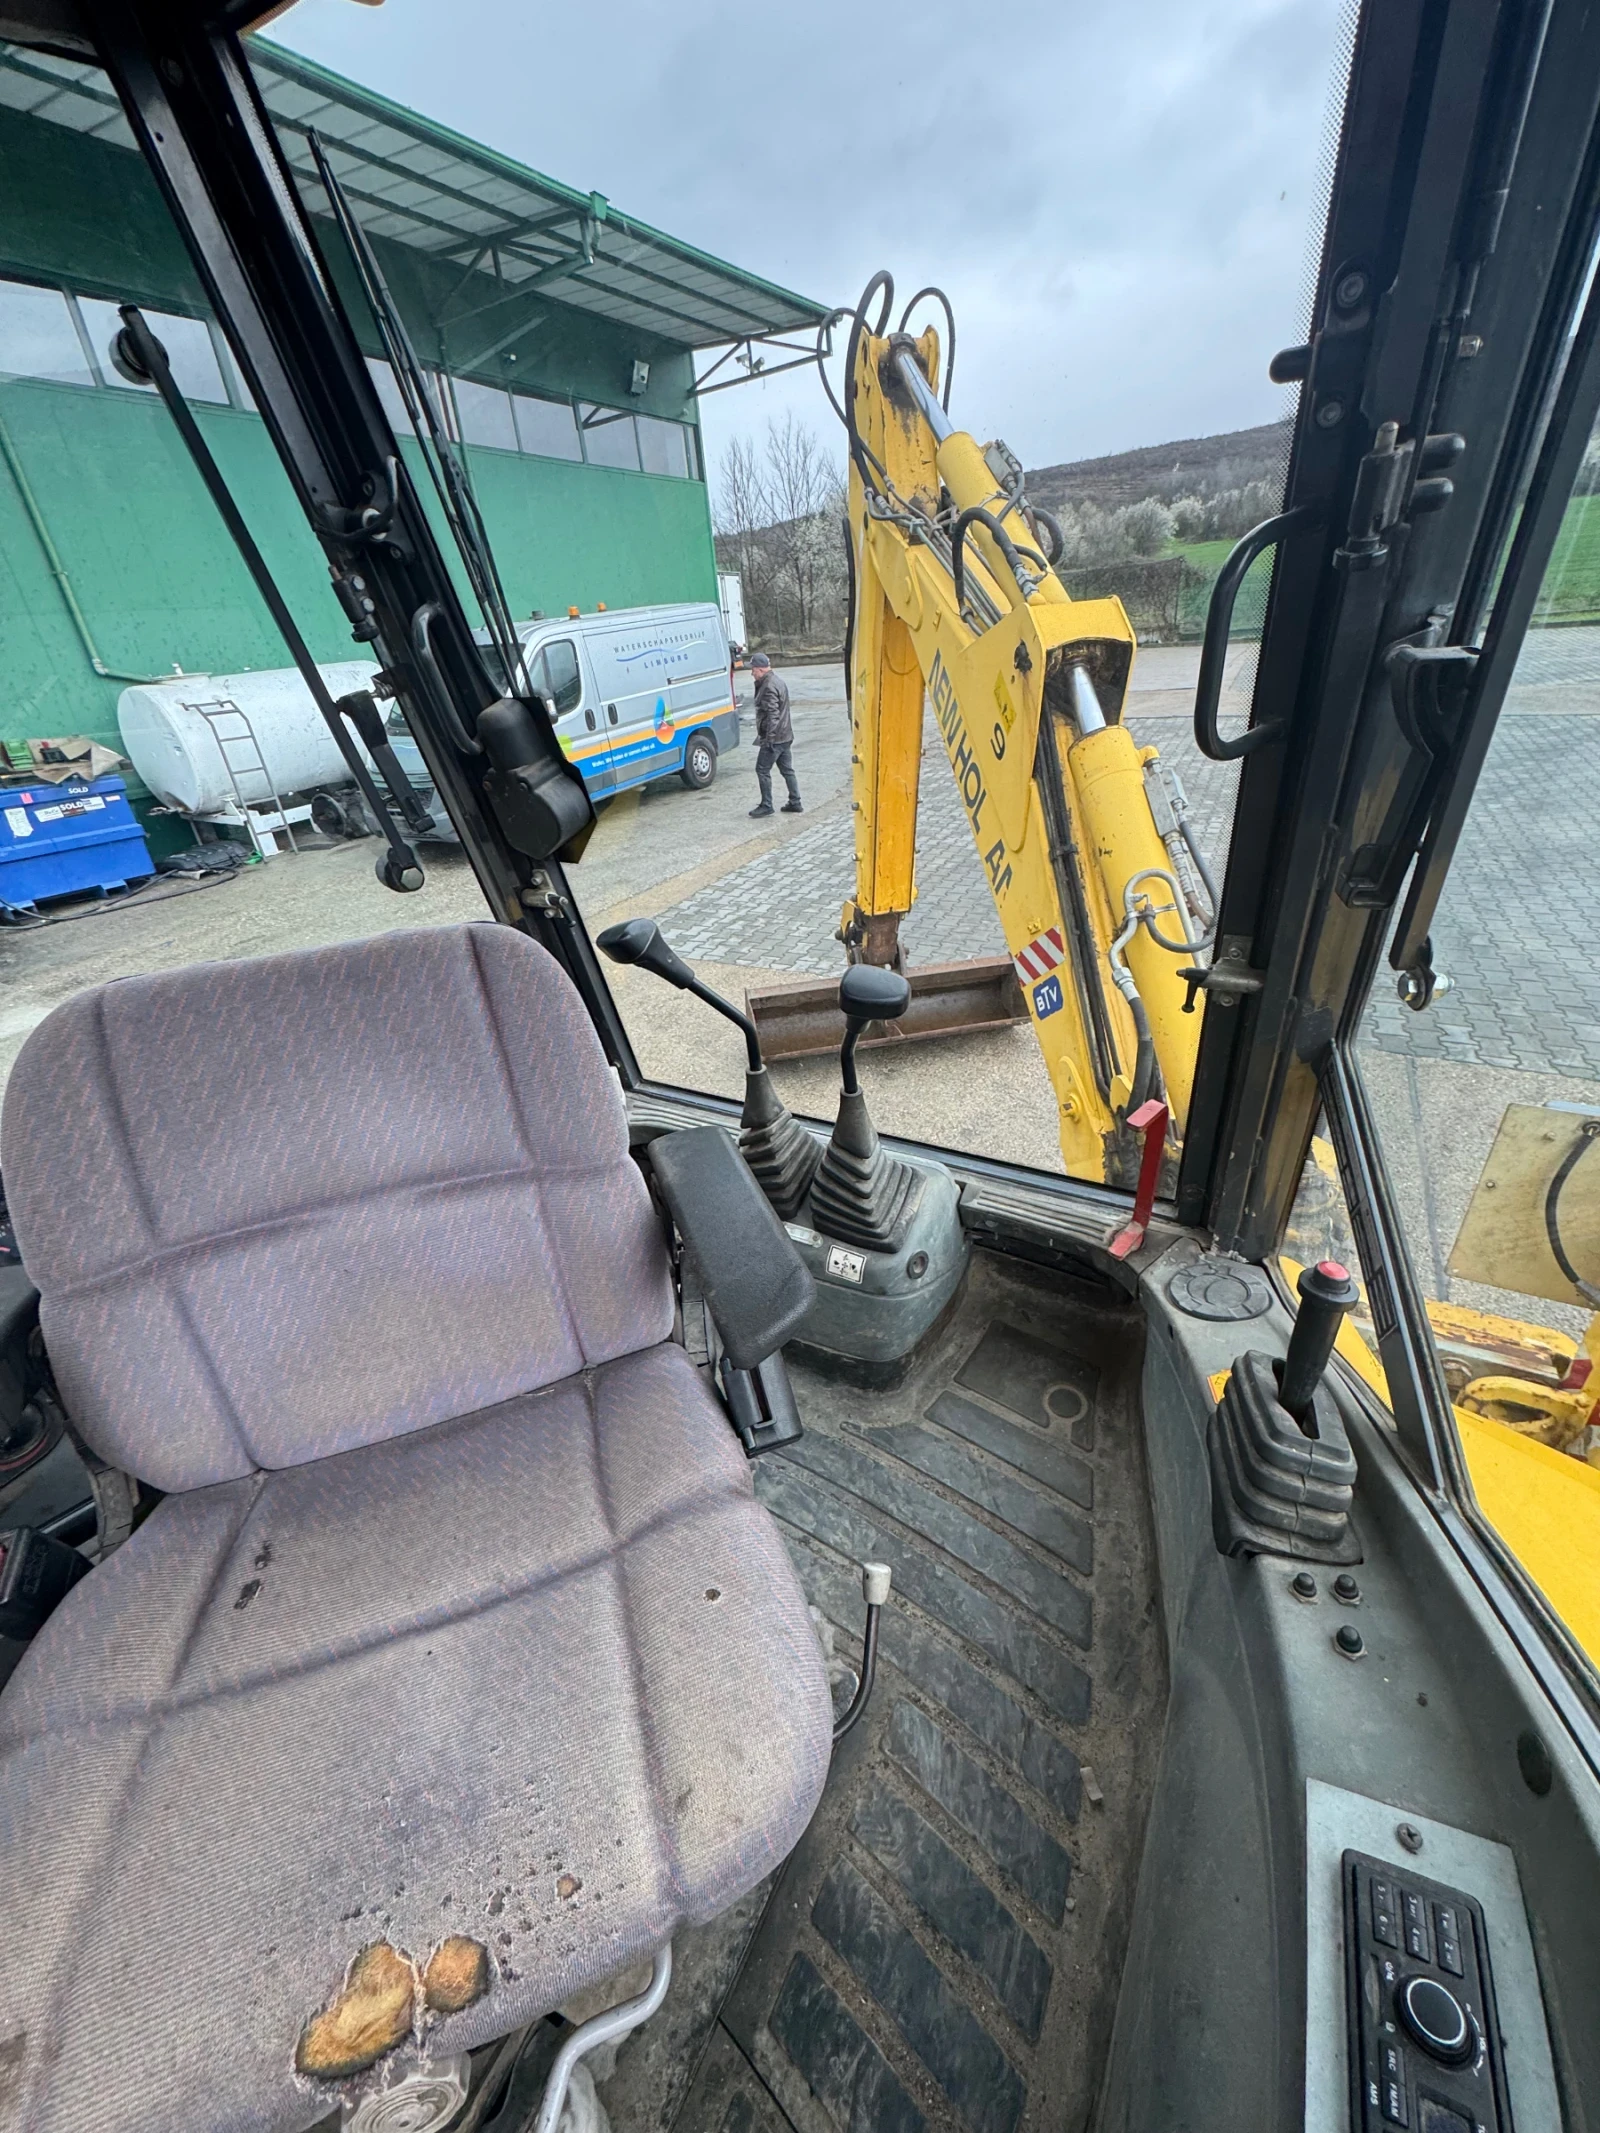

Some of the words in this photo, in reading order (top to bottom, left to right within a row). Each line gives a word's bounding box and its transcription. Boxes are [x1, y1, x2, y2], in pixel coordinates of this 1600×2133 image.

[613, 631, 706, 654] WATERSCHAPSBEDRIJF
[644, 653, 689, 669] LIMBURG
[67, 786, 89, 794] SOLD
[60, 801, 84, 811] SOLD
[1036, 985, 1057, 1012] BTV
[1408, 1896, 1418, 1904] 3
[1379, 1915, 1388, 1923] 6
[1412, 1927, 1420, 1935] 4
[1444, 1941, 1454, 1950] 2
[1387, 2048, 1397, 2072] SRC
[1369, 2080, 1379, 2106] AMS
